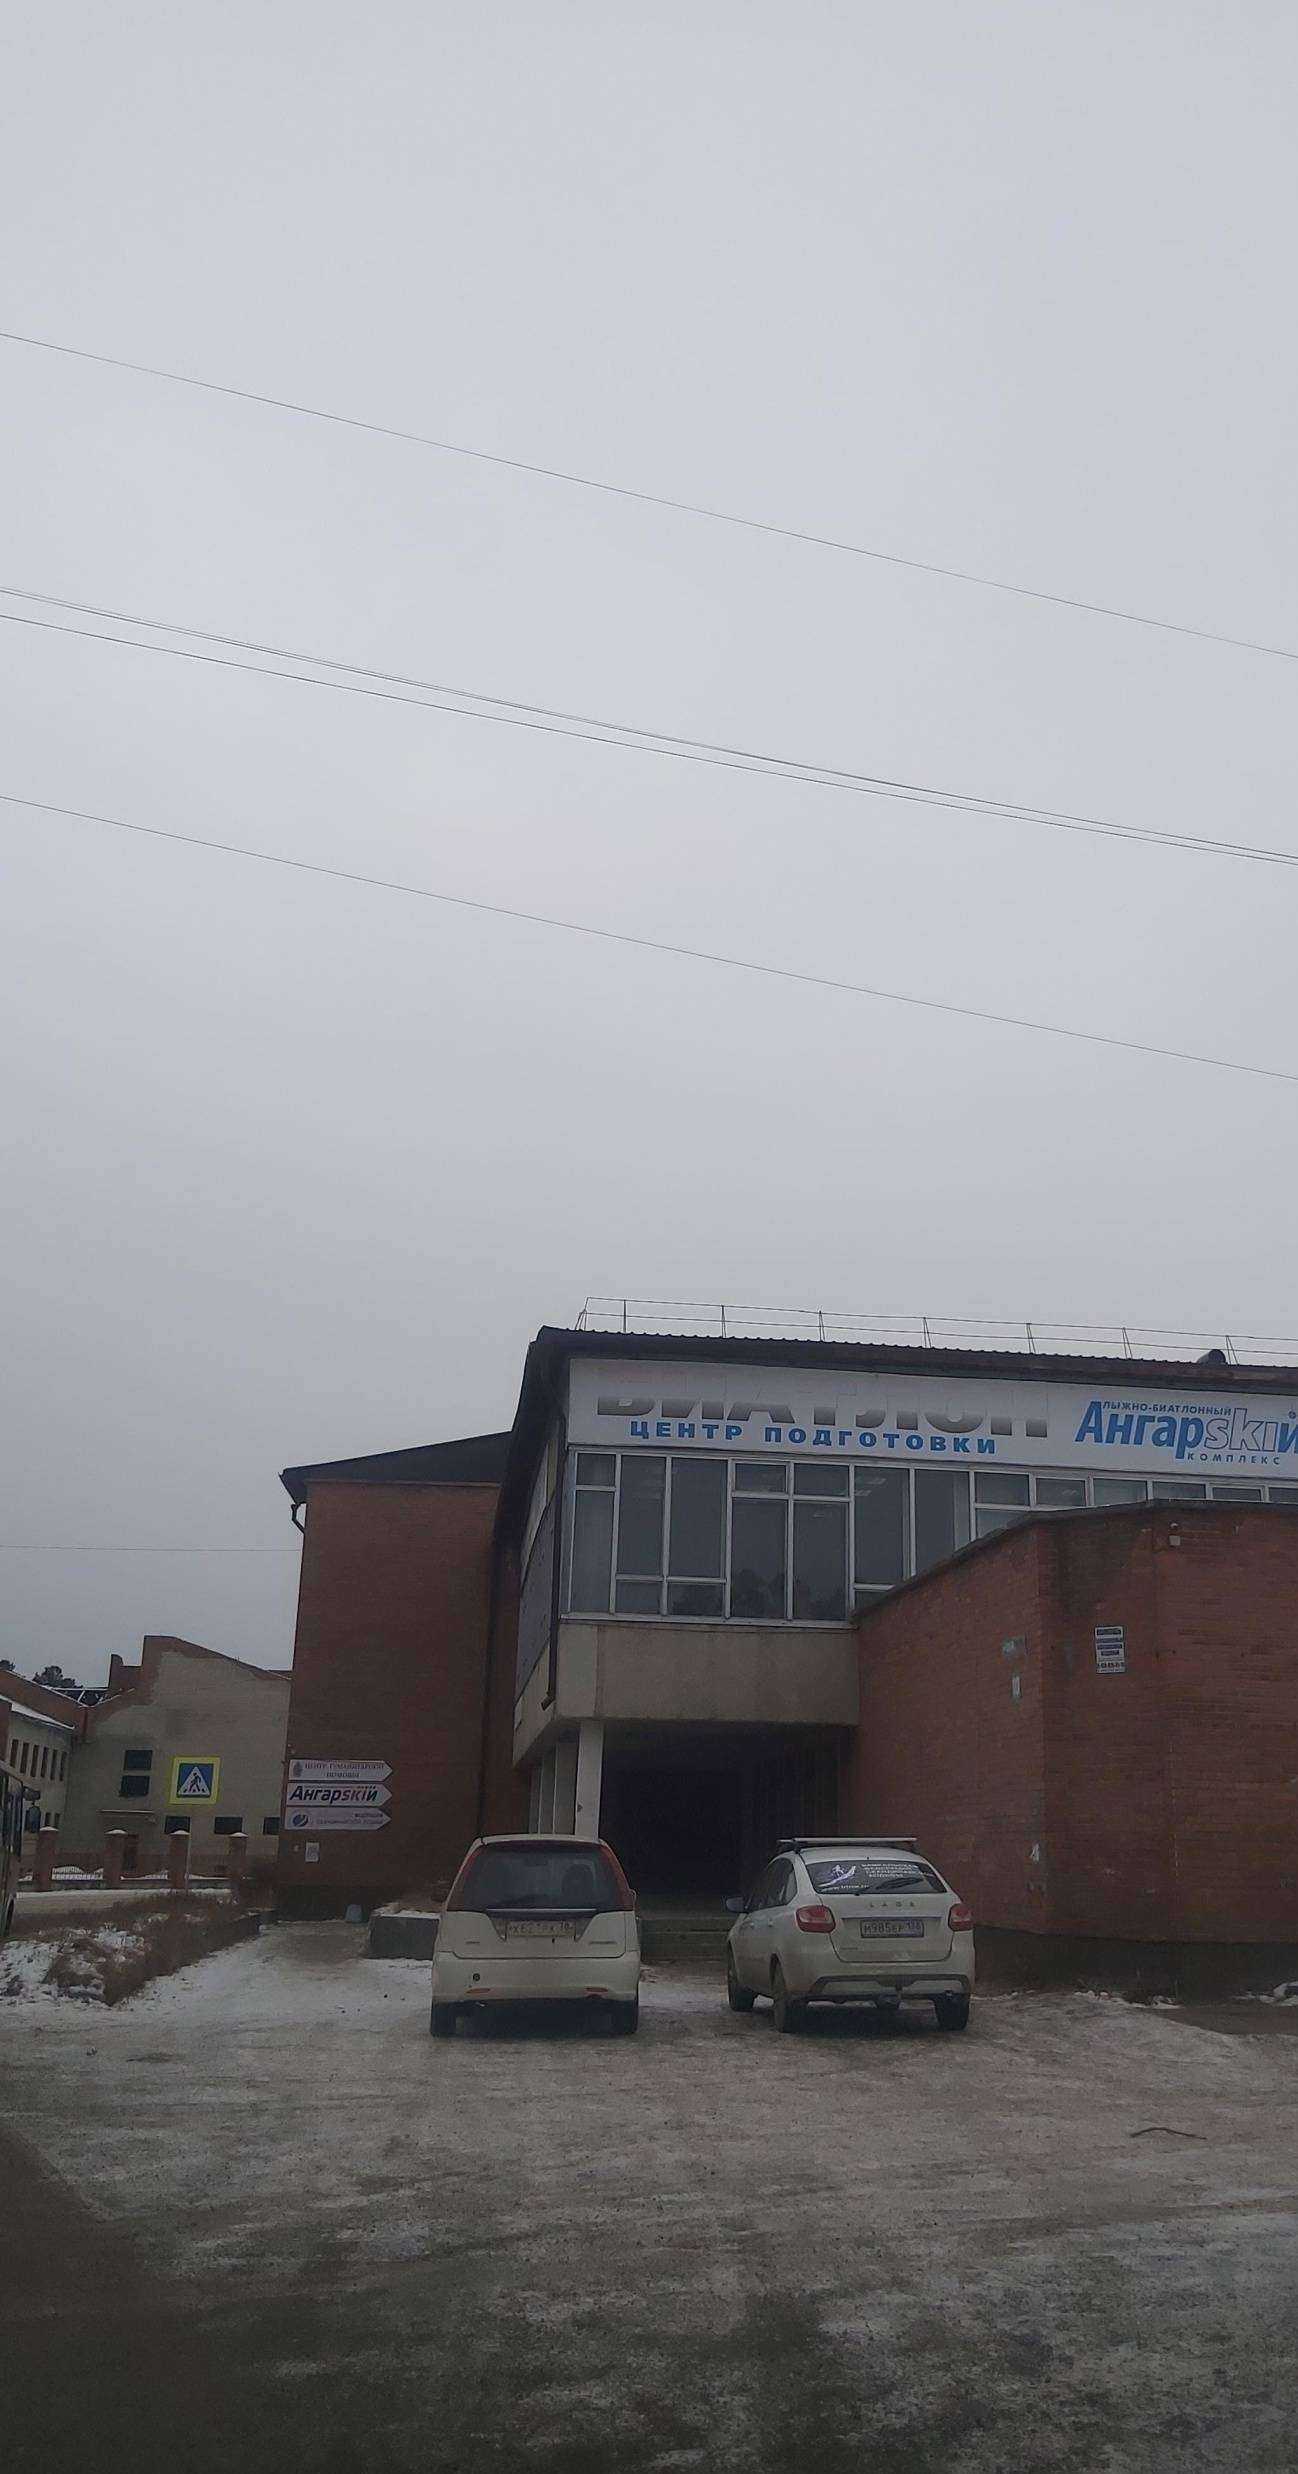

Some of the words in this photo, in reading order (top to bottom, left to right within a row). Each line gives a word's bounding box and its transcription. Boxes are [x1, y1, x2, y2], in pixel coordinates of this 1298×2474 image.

[630, 1420, 743, 1441] ЦЕНТР
[764, 1426, 996, 1455] ПОДГОТОВКИ
[1187, 1452, 1281, 1466] КОМПЛЕКС
